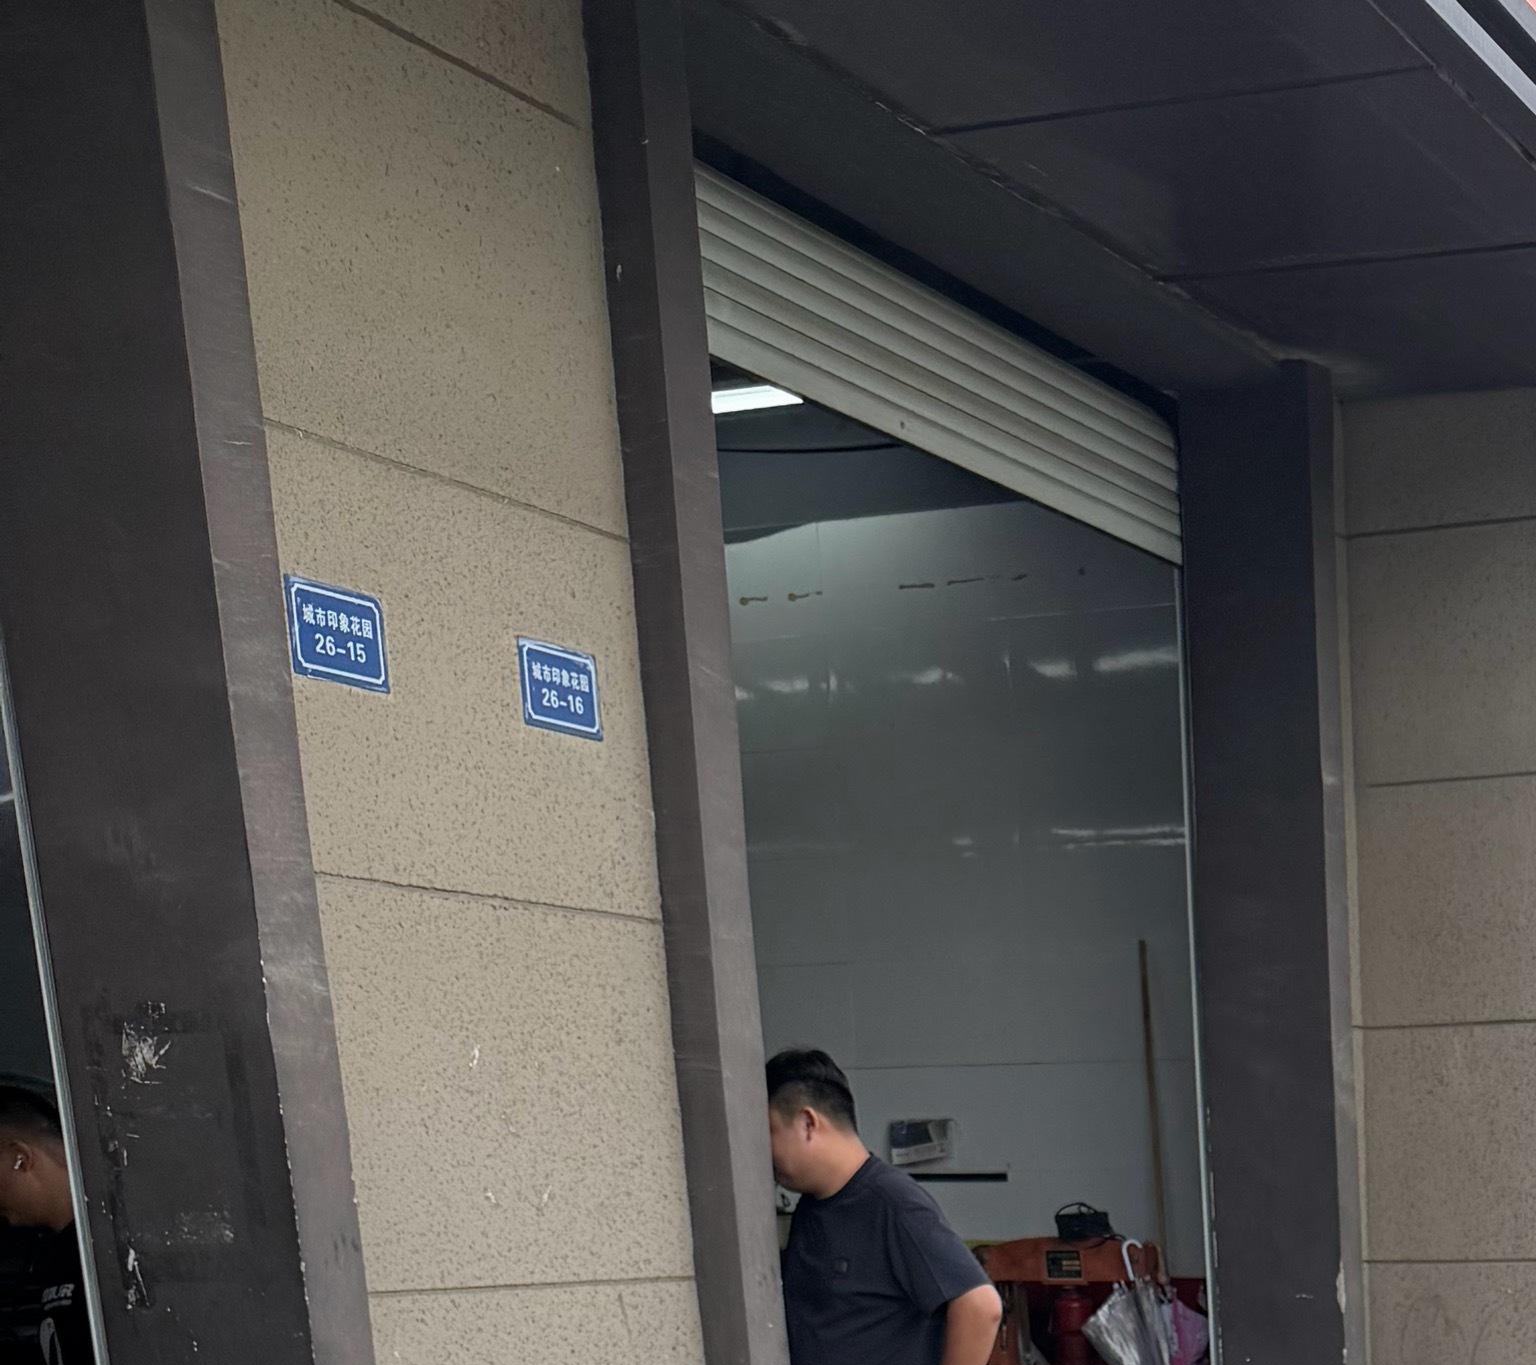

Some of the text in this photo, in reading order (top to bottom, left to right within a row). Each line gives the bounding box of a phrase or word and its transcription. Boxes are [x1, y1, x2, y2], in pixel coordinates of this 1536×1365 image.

[302, 603, 373, 640] 城市印象花园
[314, 633, 366, 664] 26-15
[532, 661, 589, 693] 城市印象花园
[541, 687, 584, 715] 26-16
